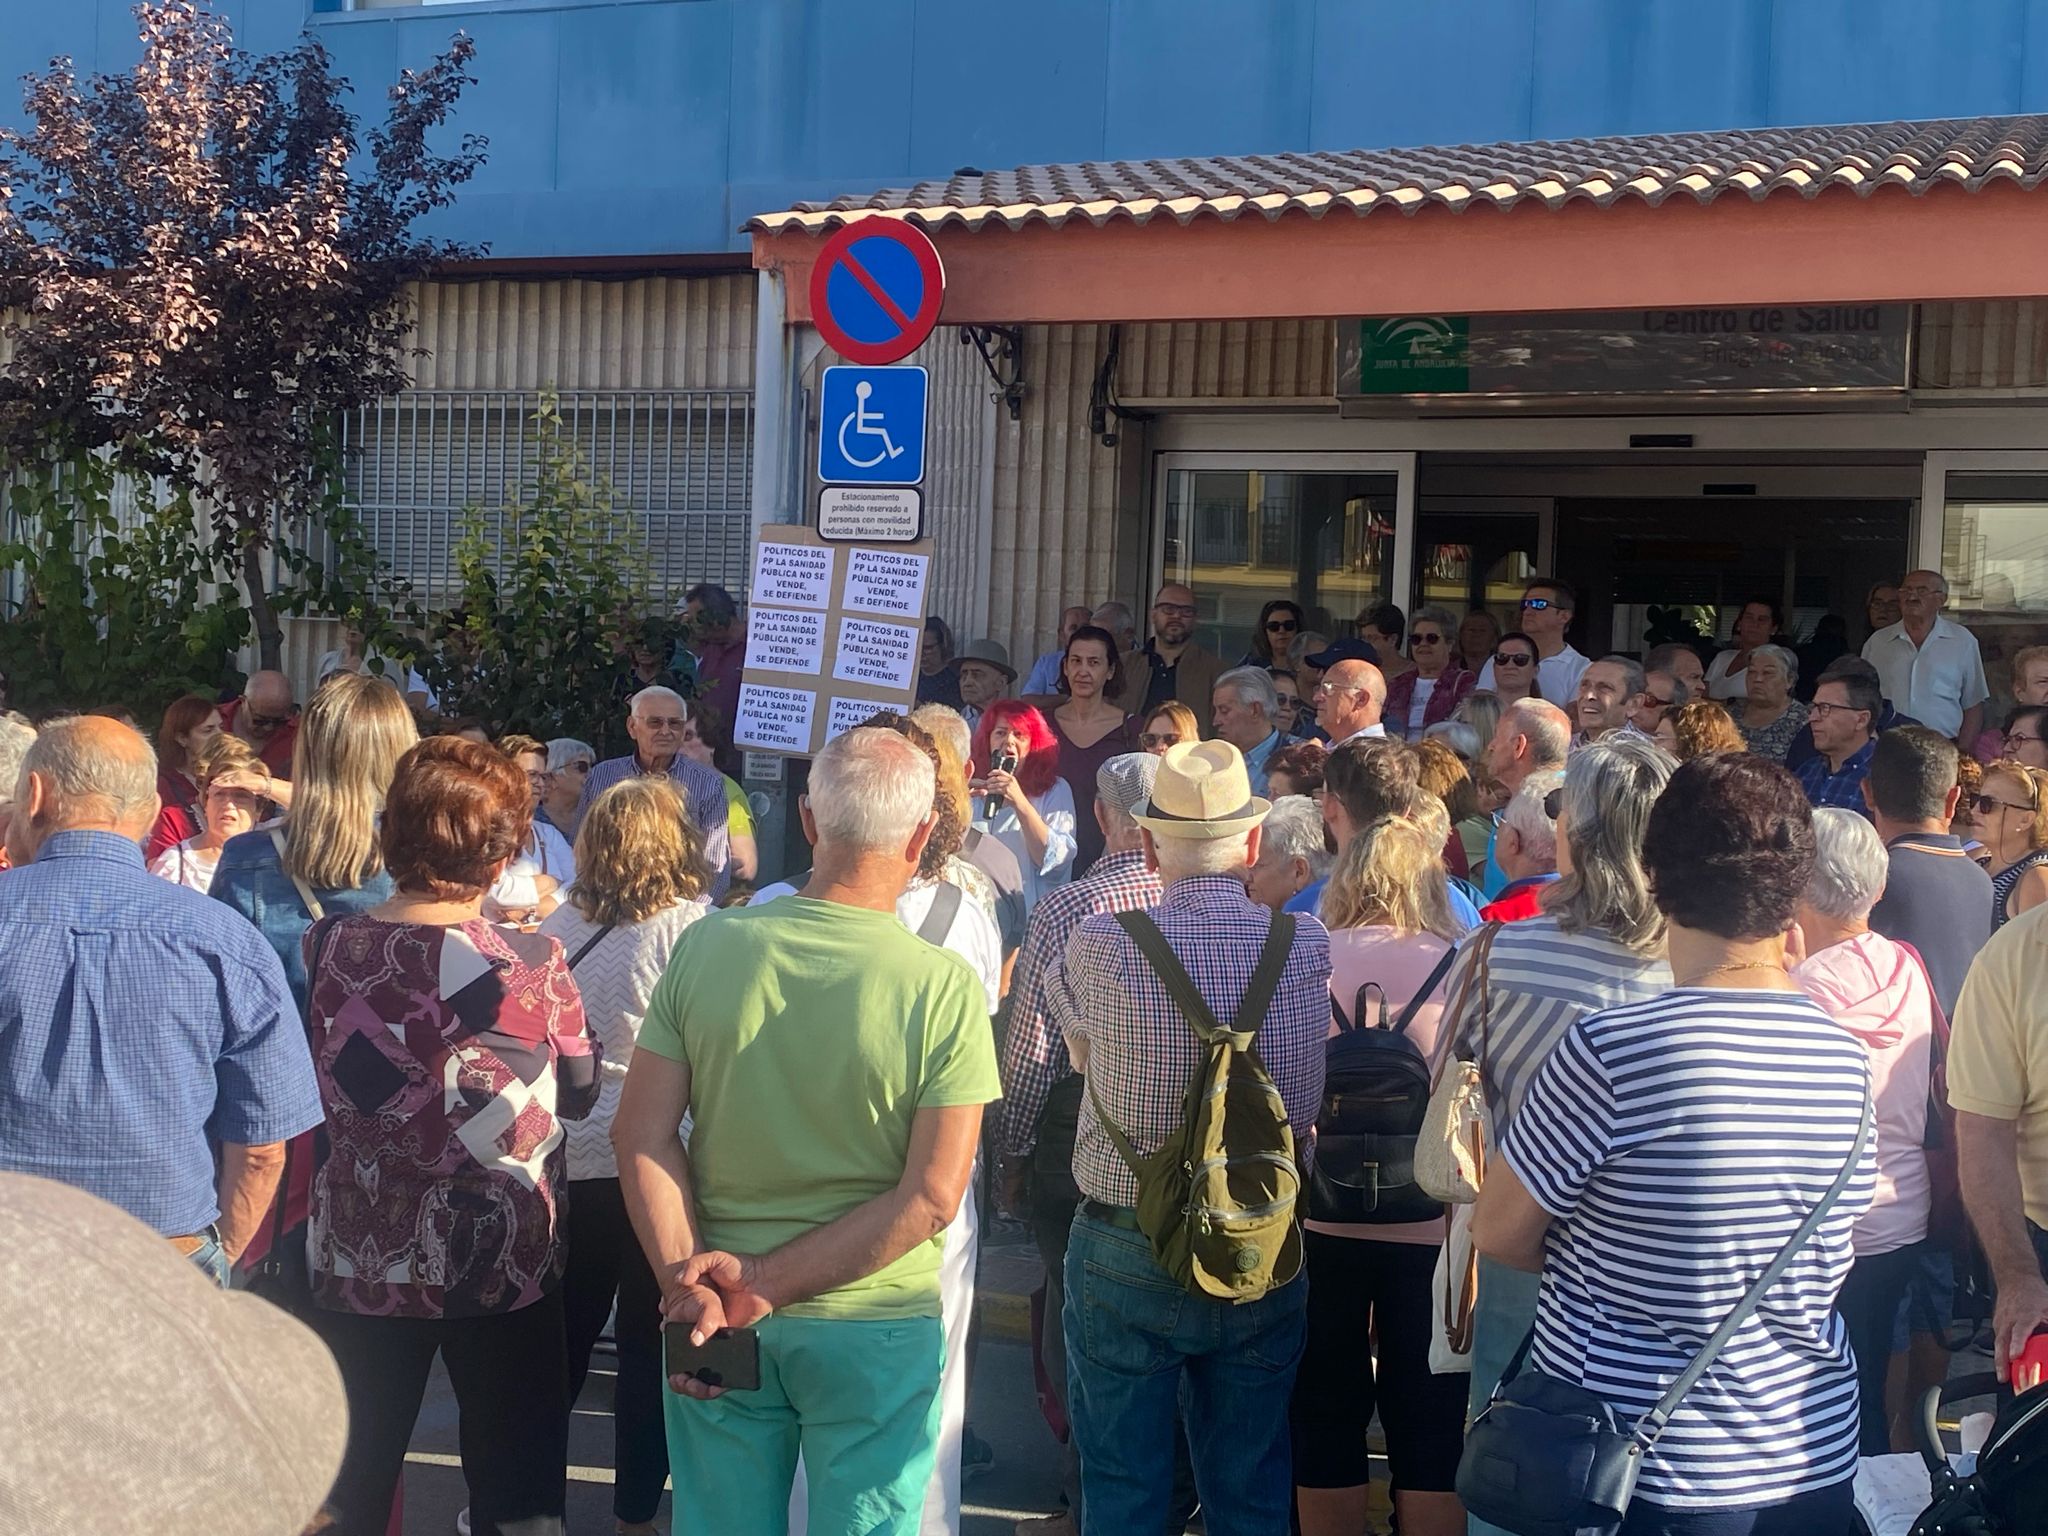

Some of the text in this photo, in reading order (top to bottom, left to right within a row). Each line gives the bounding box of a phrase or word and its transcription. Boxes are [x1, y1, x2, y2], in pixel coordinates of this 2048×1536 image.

[1643, 304, 1880, 333] Centro de Salud
[841, 492, 900, 501] Estacionamiento
[831, 504, 865, 513] prohibido
[867, 505, 902, 513] reservado
[828, 516, 860, 524] personas
[876, 516, 911, 525] movilidad
[823, 526, 915, 536] reducida (Máximo 2 horas)
[764, 546, 826, 559] POLITICOS DEL
[763, 557, 826, 569] PP LA SANIDAD
[856, 552, 920, 567] POLITICOS DEL
[800, 570, 812, 580] NO
[814, 572, 825, 581] SE
[854, 563, 919, 578] PP LA SANIDAD
[776, 580, 807, 590] VENDE,
[852, 572, 918, 589] PÚBLICA NO SE
[763, 589, 818, 601] SE DEFIENDE
[867, 586, 898, 598] VENDE,
[854, 596, 910, 610] SE DEFIENDE
[756, 611, 818, 624] POLITICOS DEL
[754, 622, 817, 635] PP LA SANIDAD
[847, 622, 910, 638] POLITICOS DEL
[753, 632, 817, 646] PÚBLICA NO SE
[845, 633, 909, 649] PP LA SANIDAD
[769, 646, 799, 656] VENDE,
[882, 649, 895, 658] NO
[897, 652, 908, 661] SE
[756, 655, 810, 667] SE DEFIENDE
[858, 657, 889, 669] VENDE,
[845, 666, 900, 682] SE DEFIENDE
[746, 687, 808, 702] POLITICOS DEL
[744, 698, 807, 713] PP LA SANIDAD
[836, 701, 881, 712] POLITICOS
[781, 714, 793, 722] NO
[795, 715, 806, 724] SE
[834, 712, 846, 720] PP
[848, 714, 859, 722] LA
[758, 722, 788, 732] VENDE,
[744, 731, 798, 745] SE DEFIENDE
